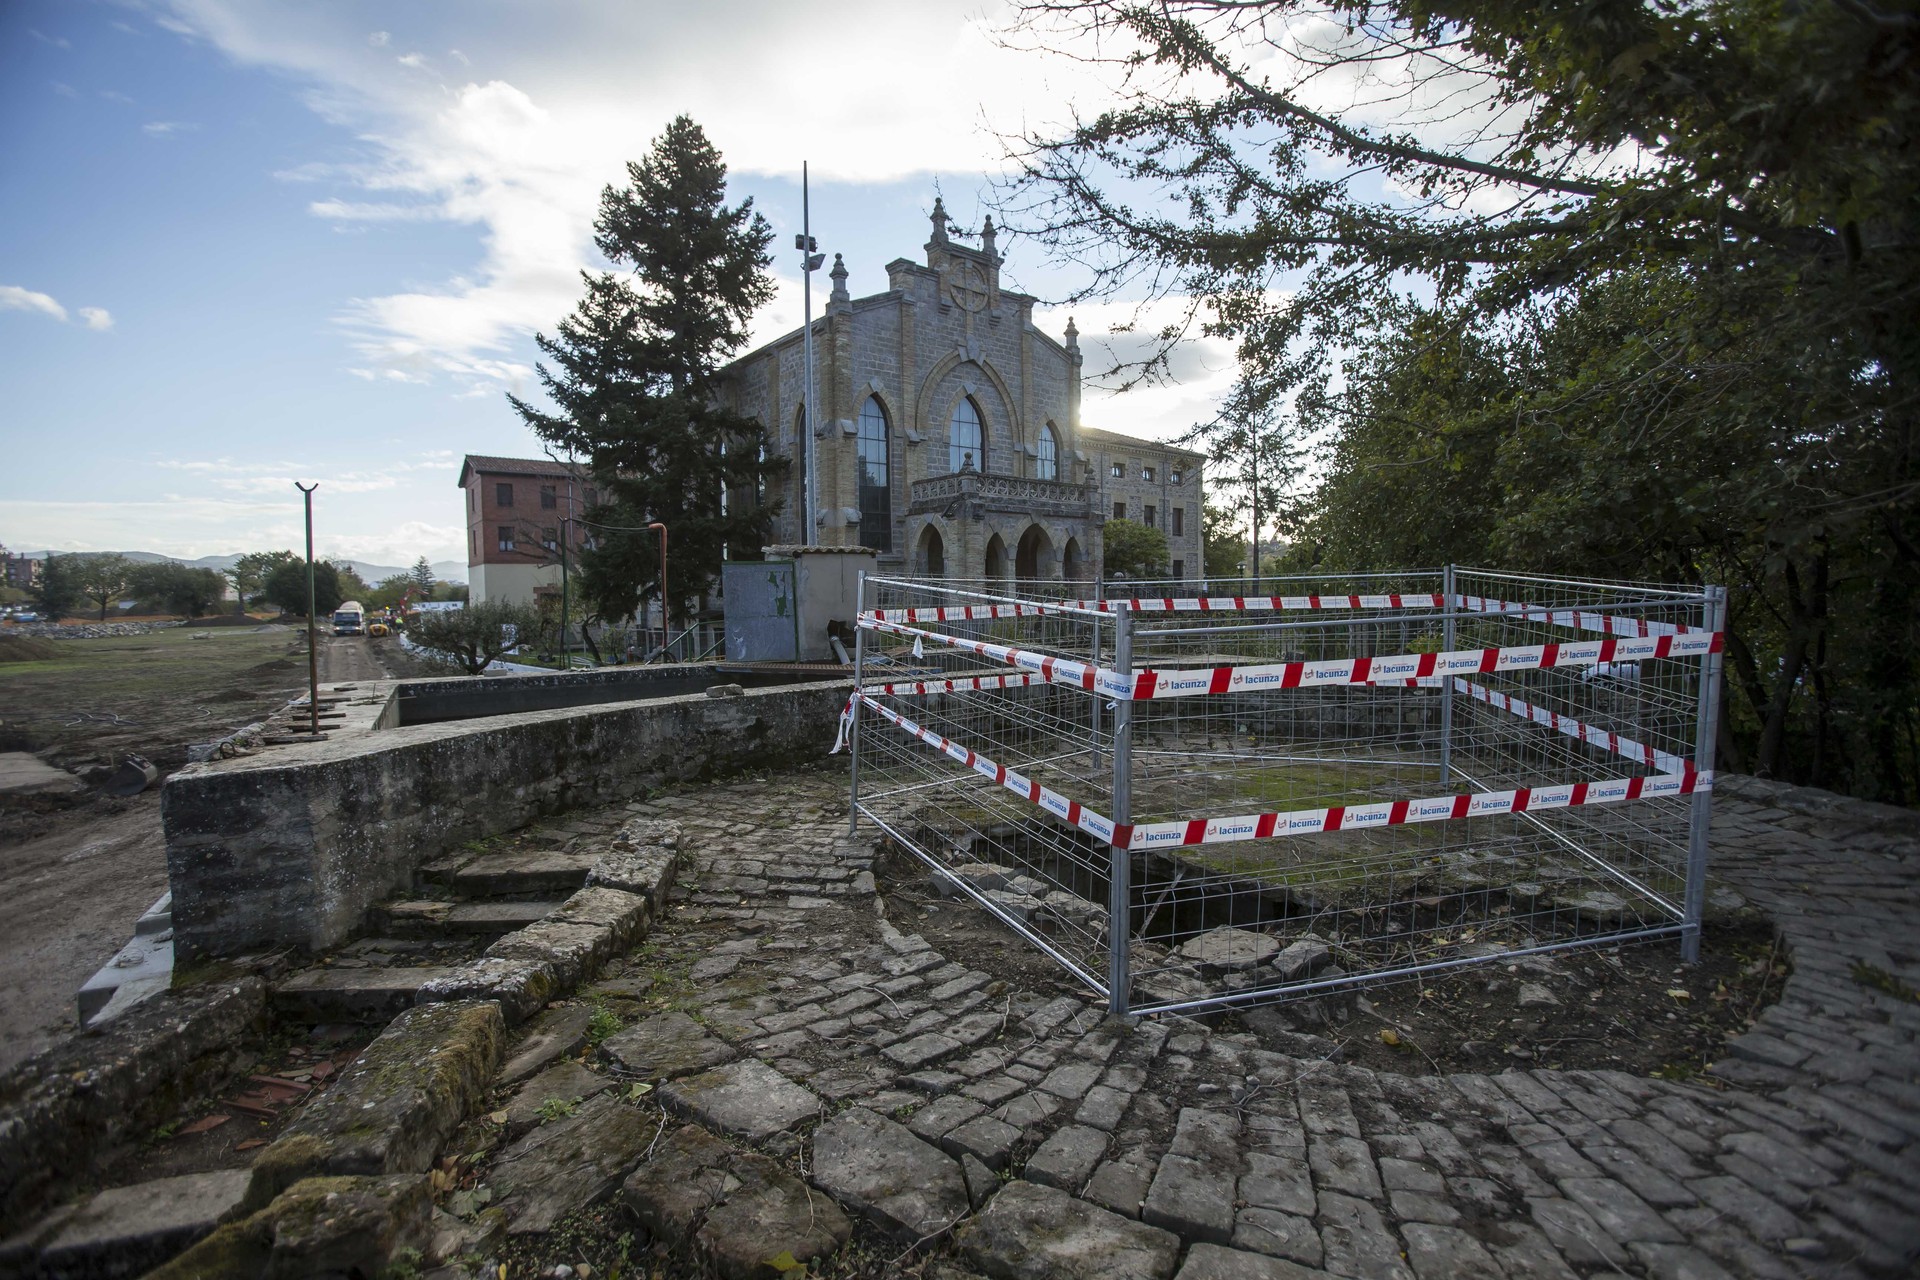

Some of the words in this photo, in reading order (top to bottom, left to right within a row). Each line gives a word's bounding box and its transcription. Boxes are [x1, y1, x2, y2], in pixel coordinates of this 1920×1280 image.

[1682, 641, 1708, 649] lacunza
[1569, 650, 1597, 658] lacunza
[1627, 646, 1654, 654] lacunza
[1510, 655, 1539, 663] lacunza
[1022, 659, 1040, 669] lacunza
[1448, 660, 1479, 668] lacunza
[1384, 665, 1415, 673] lacunza
[1060, 669, 1081, 681] lacunza
[1317, 670, 1349, 678] lacunza
[1245, 675, 1279, 684] lacunza
[1104, 679, 1131, 694] lacunza
[1171, 680, 1207, 689] lacunza
[1012, 777, 1029, 792] lacunza
[1653, 783, 1680, 792] lacunza
[1598, 788, 1626, 797] lacunza
[1541, 794, 1569, 803] lacunza
[1047, 797, 1067, 812] lacunza
[1482, 800, 1511, 809] lacunza
[1420, 806, 1450, 815] lacunza
[1356, 812, 1387, 822] lacunza
[1088, 818, 1111, 836] lacunza
[1289, 819, 1321, 828] lacunza
[1219, 825, 1253, 835] lacunza
[1146, 832, 1182, 841] lacunza
